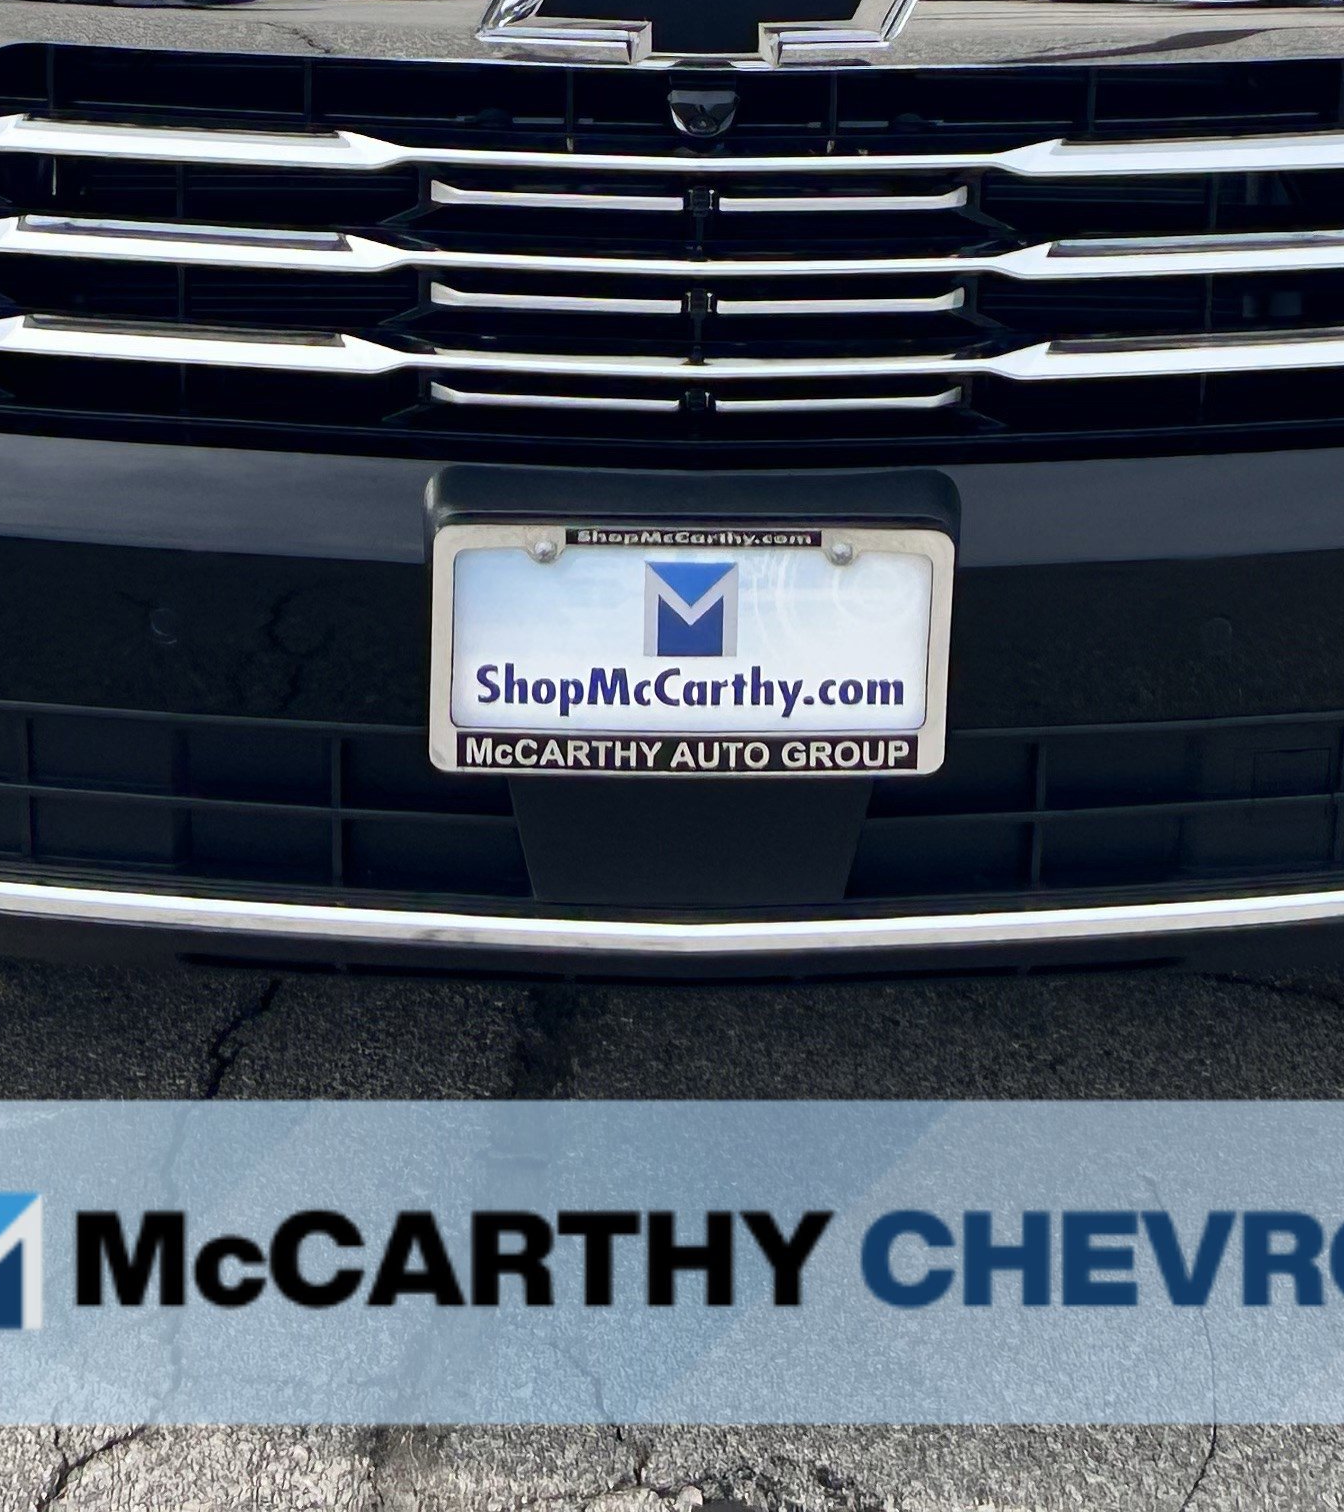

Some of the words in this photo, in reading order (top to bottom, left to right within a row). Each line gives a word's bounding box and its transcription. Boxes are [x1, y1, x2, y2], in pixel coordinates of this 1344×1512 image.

[577, 530, 812, 546] ShopMcCarthy.com
[476, 662, 905, 718] ShopMcCarthy.com
[464, 737, 663, 769] McCARTHY
[669, 740, 771, 770] AUTO
[781, 740, 911, 769] GROUP
